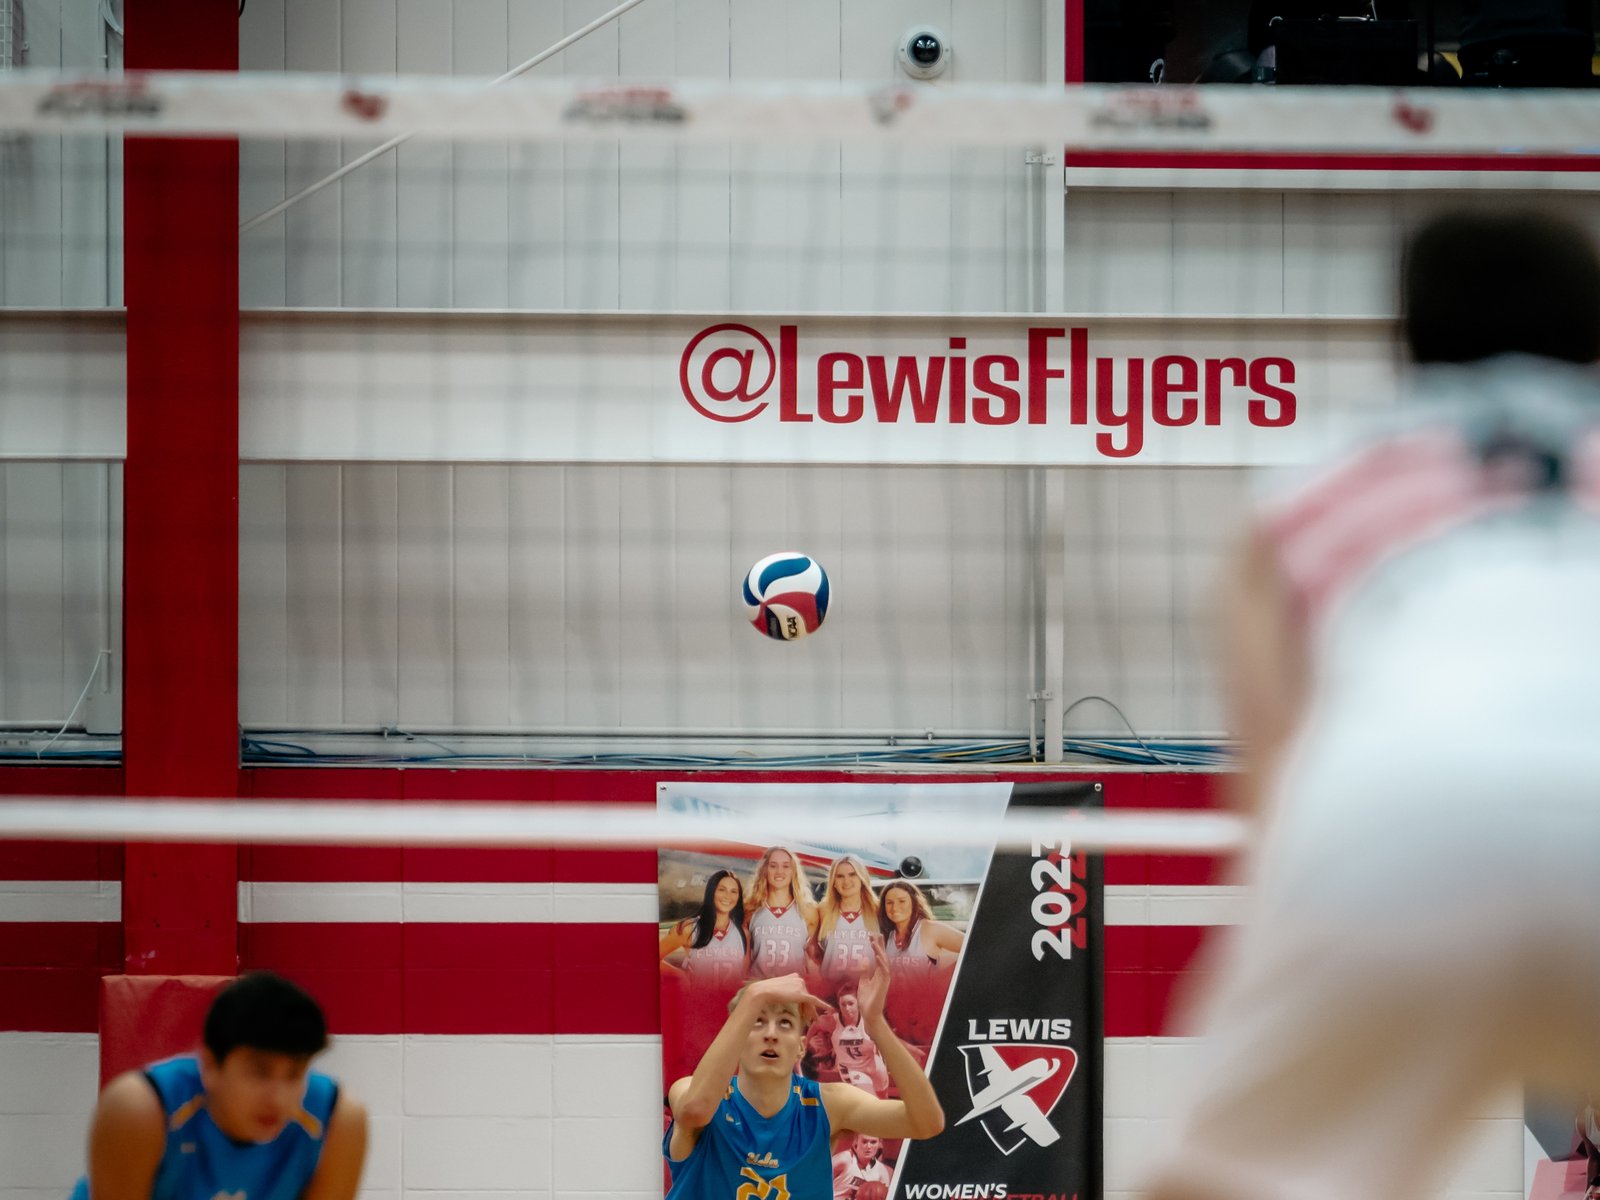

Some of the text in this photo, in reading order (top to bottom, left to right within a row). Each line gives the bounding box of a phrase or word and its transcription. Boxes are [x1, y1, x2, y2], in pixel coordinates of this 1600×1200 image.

[679, 323, 1298, 458] @LewisFlyers
[754, 925, 801, 938] FLYERS
[766, 939, 791, 968] 33
[838, 944, 864, 970] 35
[968, 1018, 1071, 1041] LEWIS
[905, 1183, 1007, 1200] WOMEN'S
